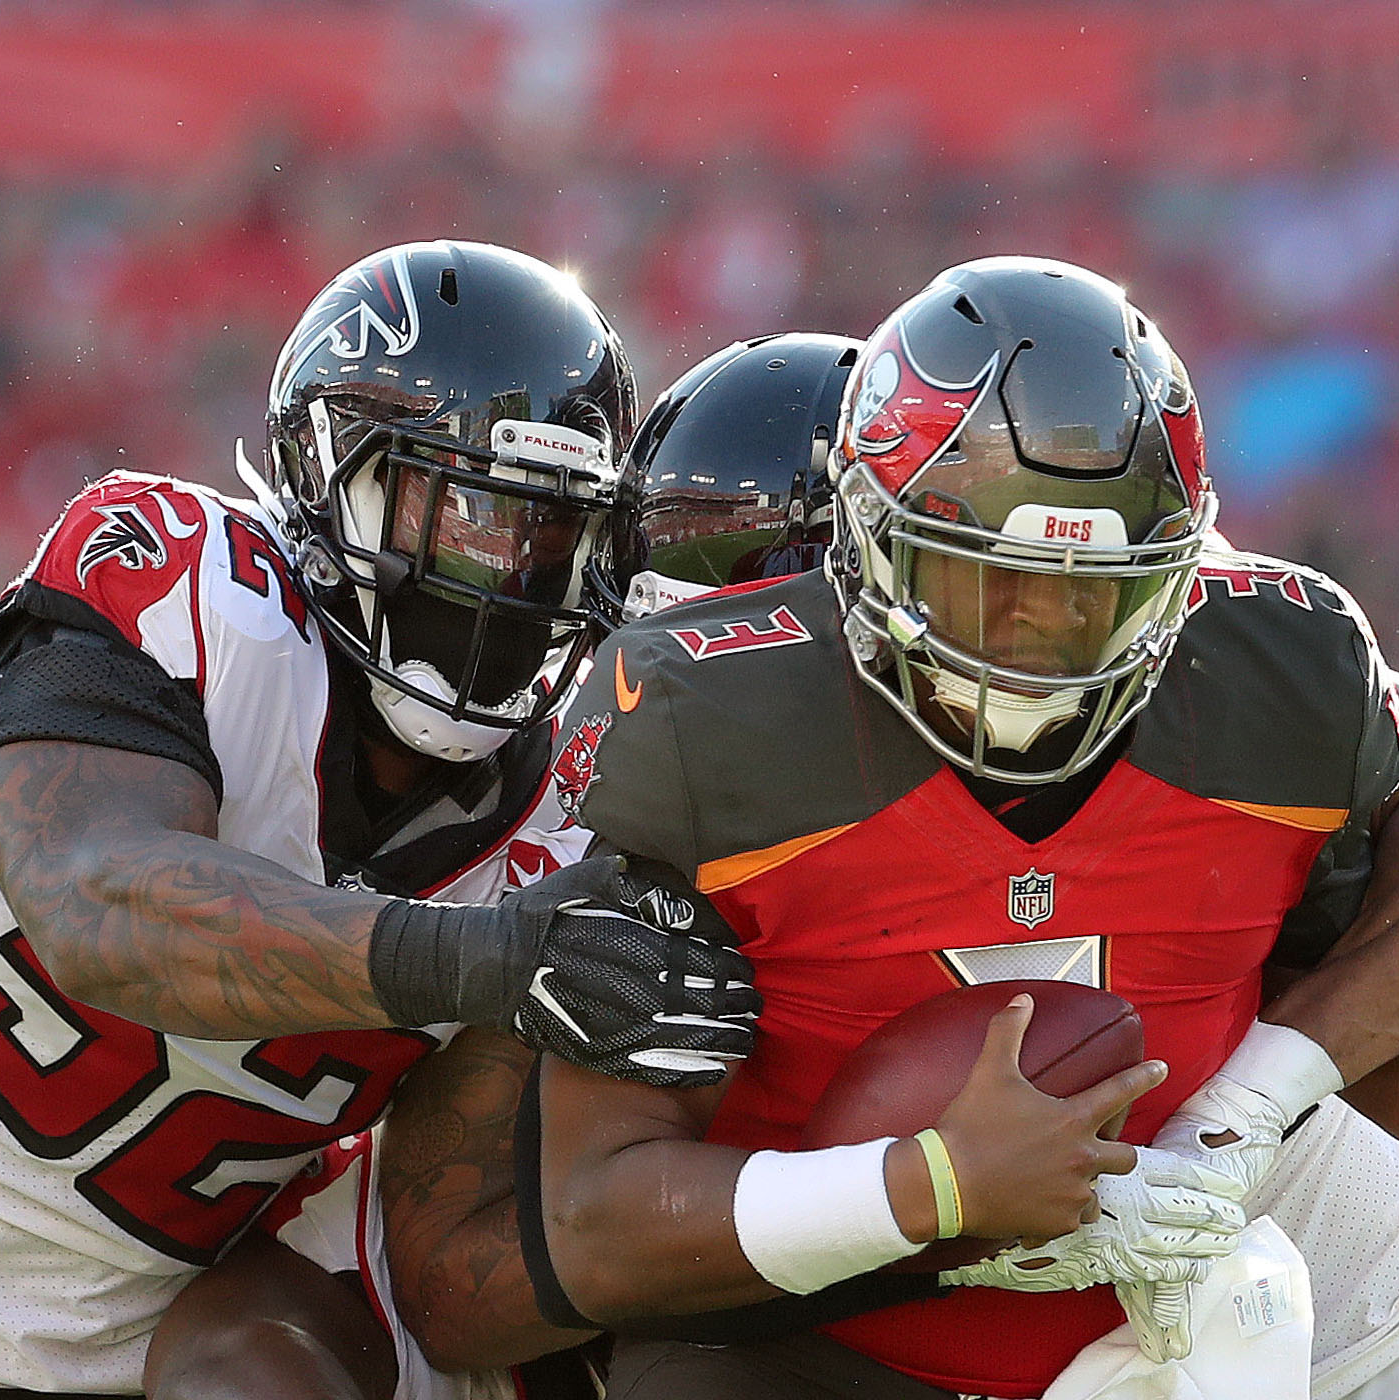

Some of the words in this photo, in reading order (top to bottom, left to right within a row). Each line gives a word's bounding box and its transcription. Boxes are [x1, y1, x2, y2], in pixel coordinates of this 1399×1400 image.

[524, 434, 585, 455] FALCONS
[665, 604, 814, 662] 3
[1016, 896, 1047, 918] NFL
